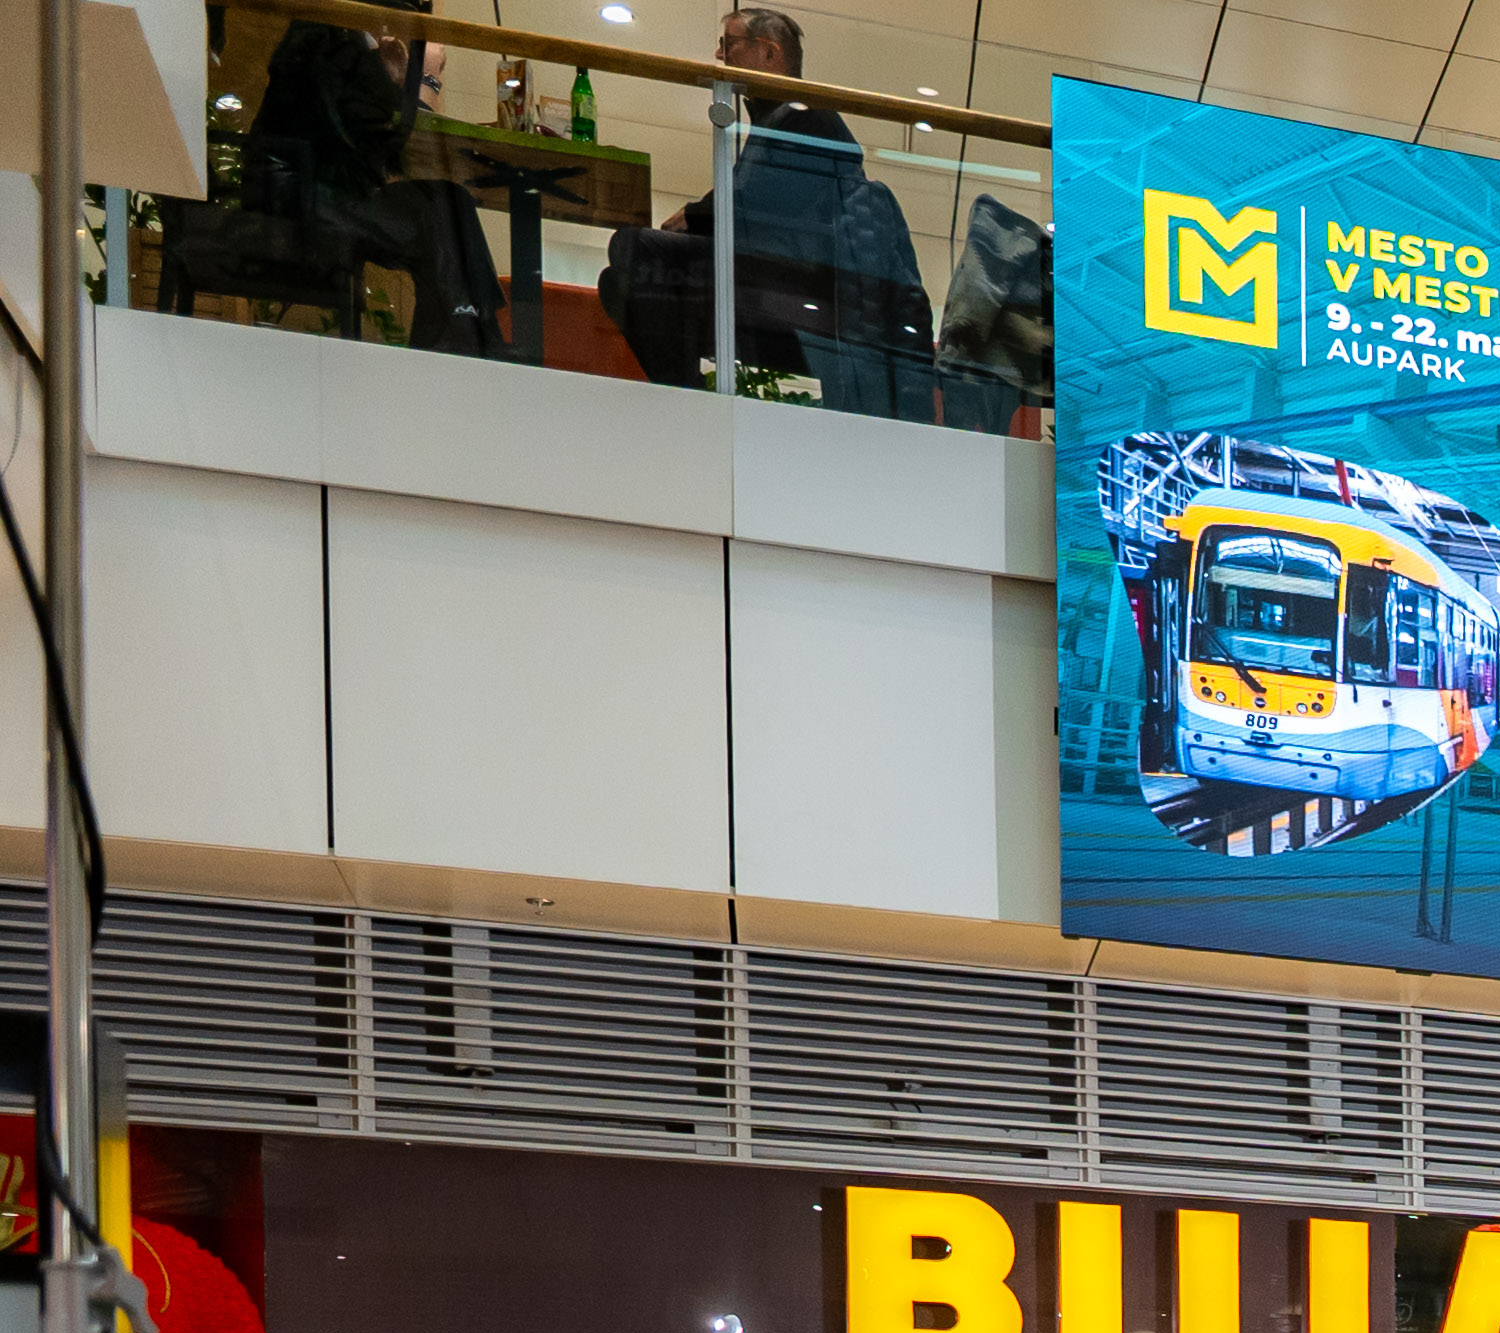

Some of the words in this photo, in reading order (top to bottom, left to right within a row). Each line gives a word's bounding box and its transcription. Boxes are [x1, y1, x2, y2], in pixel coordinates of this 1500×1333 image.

[1327, 221, 1489, 278] MESTO
[1325, 259, 1361, 294] V
[1325, 303, 1361, 334] 9.
[1391, 314, 1448, 347] 22.
[1325, 338, 1467, 382] AUPARK
[1245, 713, 1279, 730] 809
